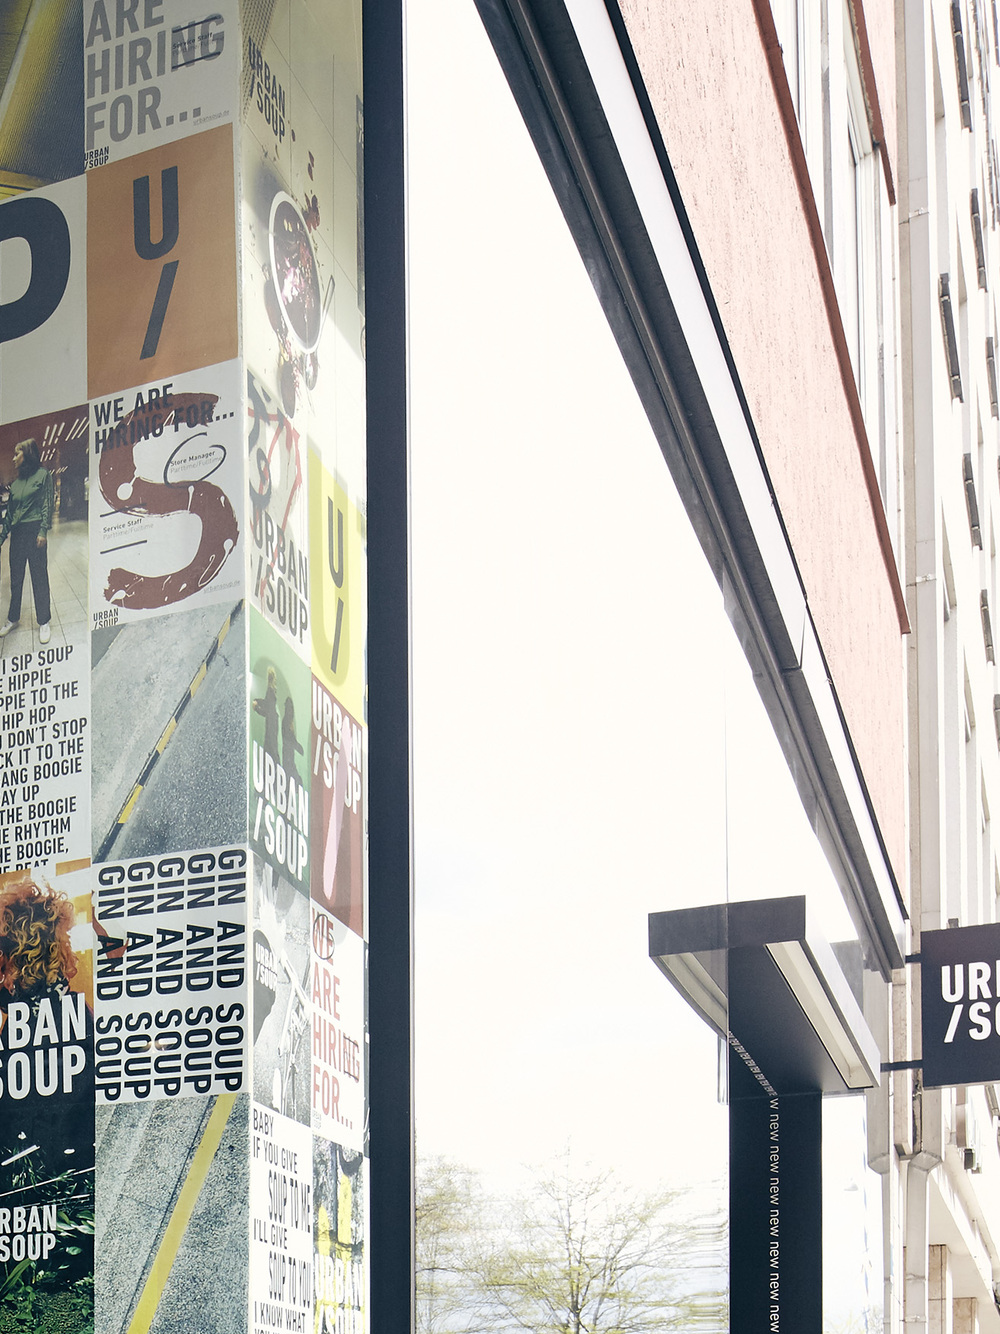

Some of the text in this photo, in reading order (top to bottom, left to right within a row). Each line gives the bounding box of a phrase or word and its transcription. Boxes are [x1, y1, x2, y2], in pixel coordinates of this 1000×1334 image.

[85, 0, 164, 48] ARE
[87, 13, 224, 99] HIRING
[249, 36, 285, 118] URBAN
[133, 165, 180, 261] U
[94, 383, 173, 427] WE ARE
[95, 413, 164, 454] HIRING
[170, 450, 215, 467] Store Manager
[103, 518, 142, 533] Service Staff
[253, 506, 308, 594] URBAN
[93, 608, 119, 621] URBAN
[2, 660, 6, 674] I
[12, 654, 32, 673] SIP
[38, 645, 73, 667] SOUP
[8, 726, 47, 748] DON'T
[52, 718, 87, 739] STOP
[33, 757, 82, 781] BOOGIE
[253, 740, 308, 838] URBAN
[14, 817, 71, 842] RHYTHM
[253, 797, 308, 881] /SOUP
[215, 849, 247, 1092] GIN AND SOUP
[313, 961, 340, 1021] ARE
[313, 1012, 359, 1083] HIRING
[253, 1108, 274, 1137] BABY
[253, 1135, 298, 1174] IF YOU GIVE
[268, 1169, 310, 1233] SOUP TO ME
[770, 1114, 779, 1301] new new new new new new
